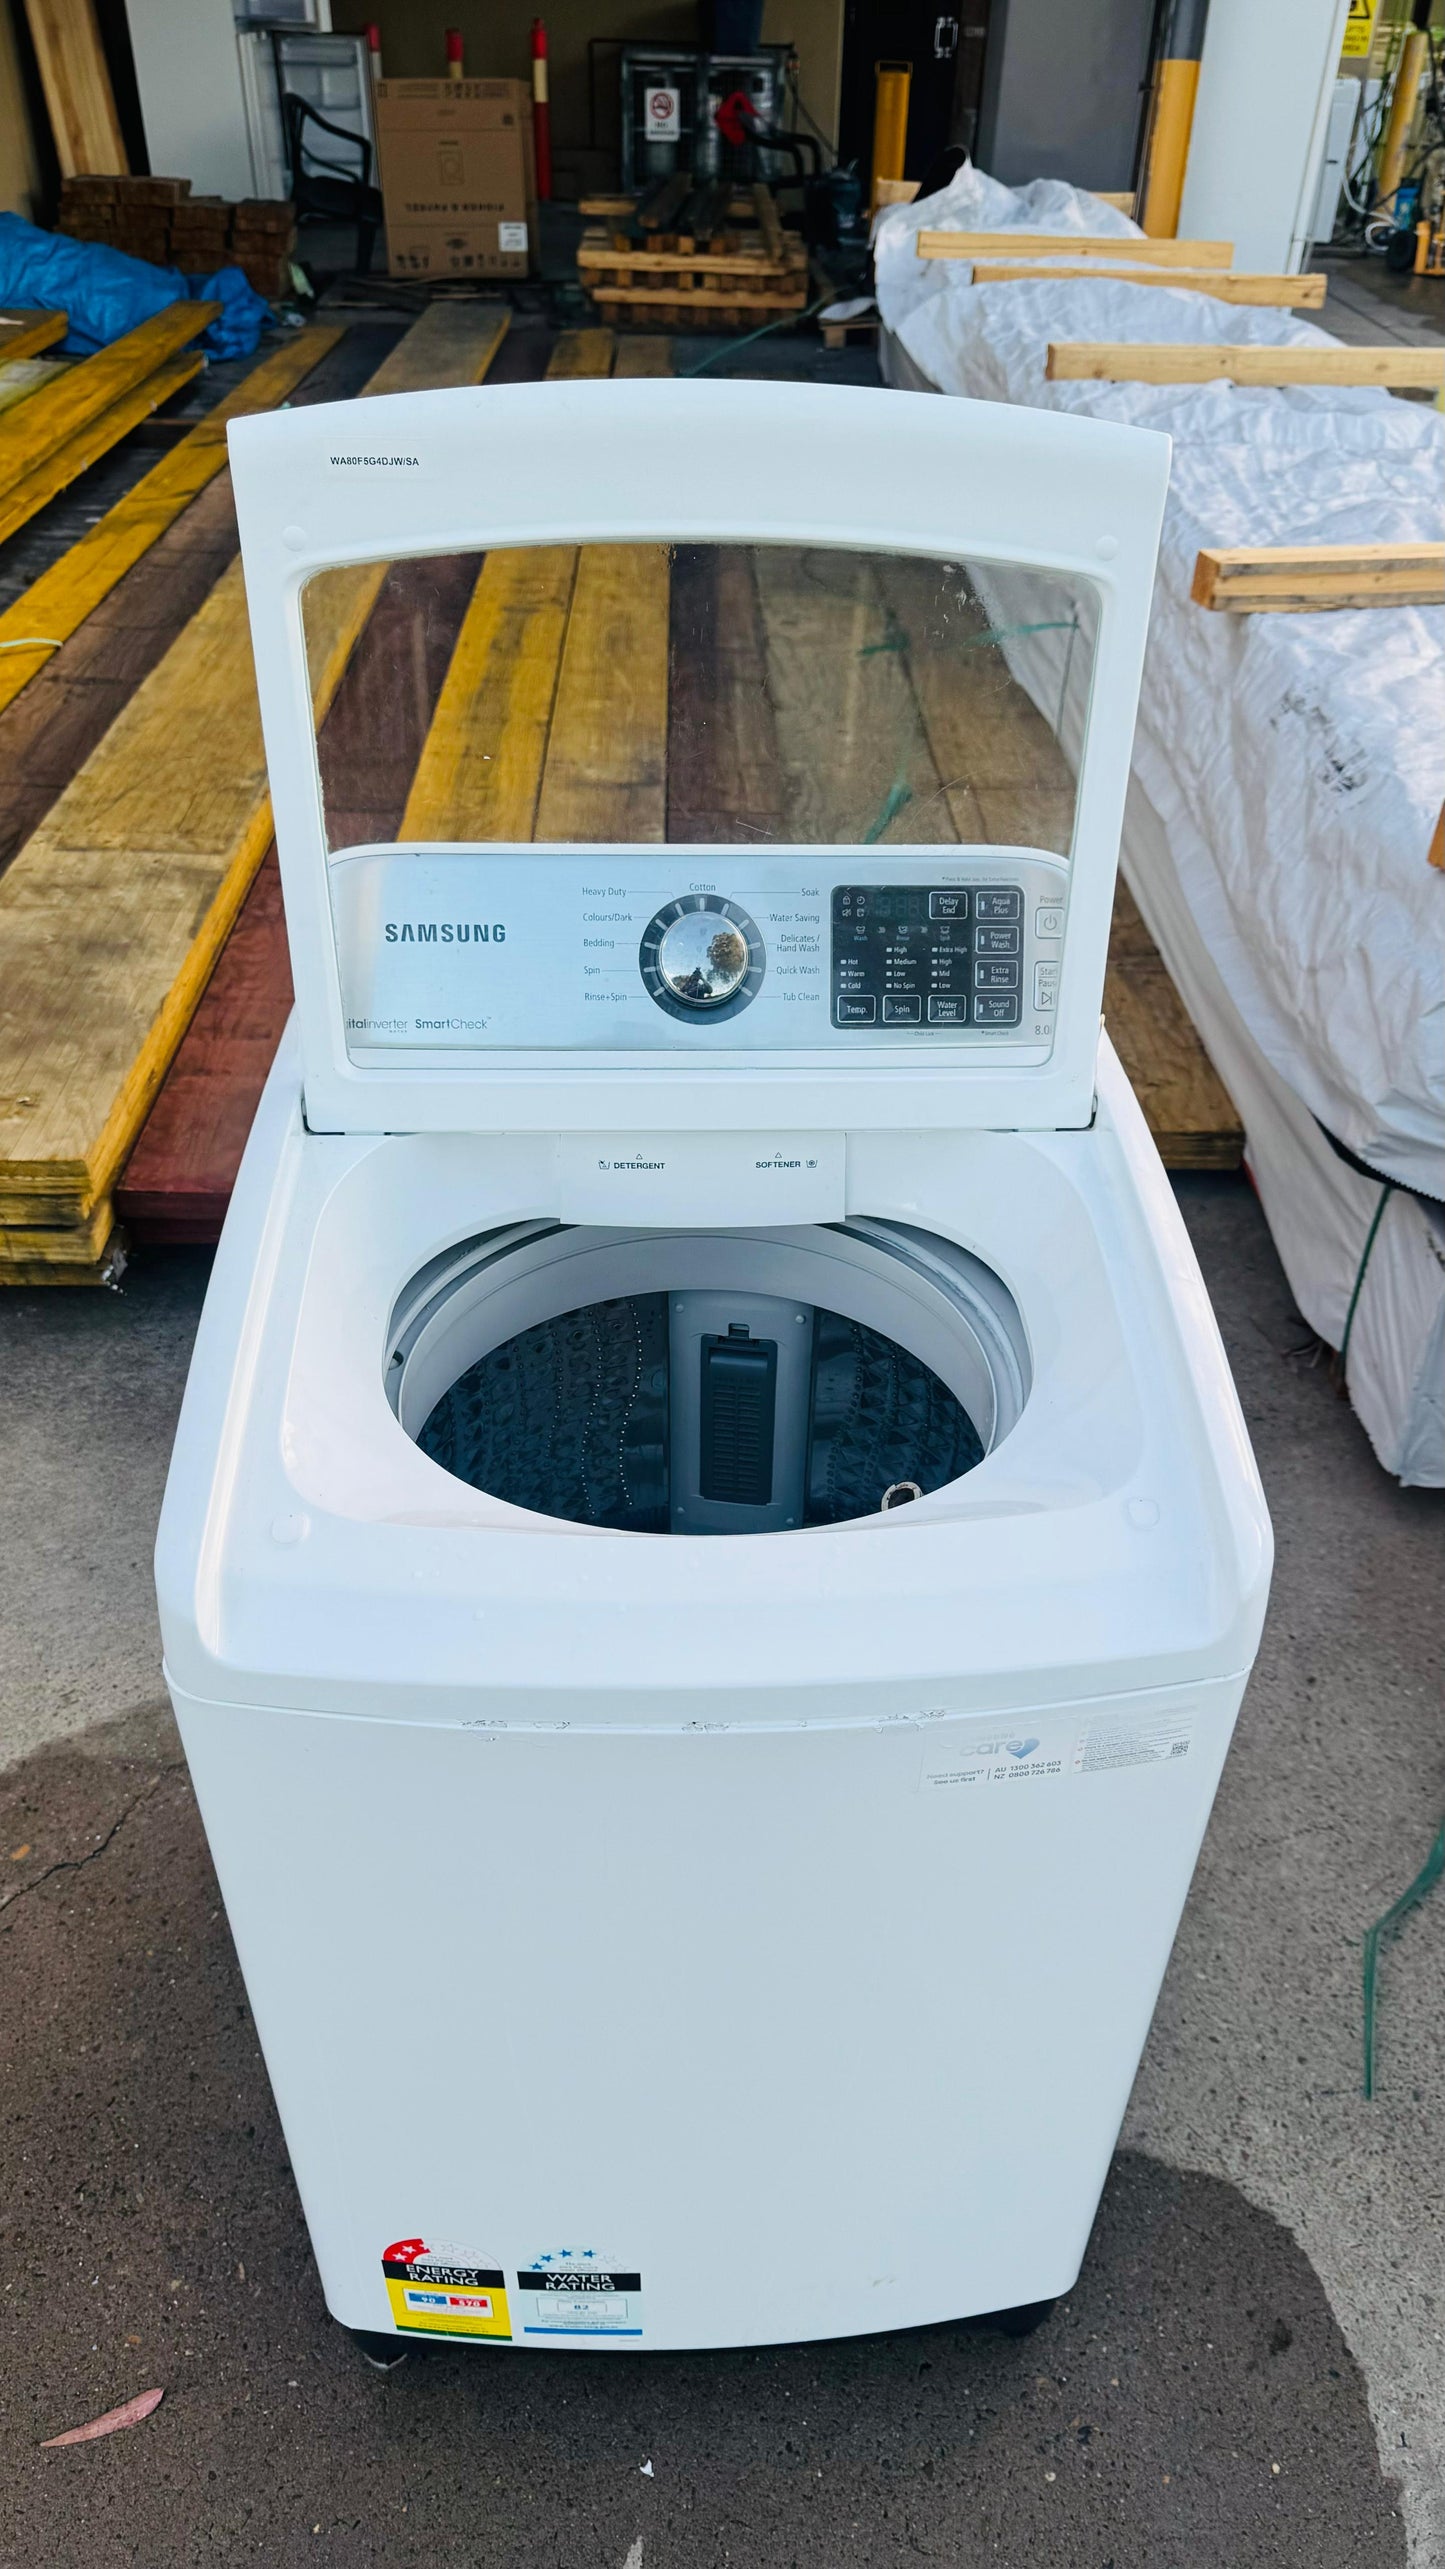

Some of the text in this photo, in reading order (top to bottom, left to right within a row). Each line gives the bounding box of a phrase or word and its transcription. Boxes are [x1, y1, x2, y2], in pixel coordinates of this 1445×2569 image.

[330, 456, 419, 466] WA80F5G4DJW/SA
[582, 887, 626, 897] Heavy Duty
[689, 883, 716, 892] Cotton
[801, 888, 820, 897] Soak
[939, 897, 959, 908] Delay
[992, 897, 1010, 907] Aqua
[1040, 895, 1063, 904] Power
[942, 906, 956, 914] End
[994, 906, 1009, 914] Plus
[583, 913, 632, 922] Colours/Dark
[770, 913, 820, 924] Water Saving
[385, 923, 506, 943] SAMSUNG
[990, 931, 1012, 940] Power
[781, 934, 815, 943] Delicates
[583, 938, 614, 949] Bedding
[991, 940, 1010, 949] Wash
[776, 944, 820, 953] Hand Wash
[939, 958, 952, 966] High
[584, 966, 600, 976] Spin
[776, 966, 820, 976] Quick Wash
[991, 966, 1009, 975] Extra
[991, 974, 1009, 983] Rinse
[584, 992, 627, 1003] Rinse+Spin
[782, 993, 820, 1002] Tub Clean
[937, 1000, 957, 1009] Water
[989, 1000, 1010, 1009] Sound
[847, 1005, 868, 1015] Temp.
[894, 1005, 910, 1015] Spin
[938, 1009, 956, 1017] Level
[993, 1008, 1005, 1017] Off
[614, 1162, 665, 1170] DETERGENT
[960, 1740, 1023, 1756] care
[1010, 1764, 1029, 1772] 1300
[949, 1769, 985, 1778] support?
[1008, 1770, 1030, 1778] 0800
[406, 2264, 479, 2278] ENERGY
[409, 2273, 478, 2286] RATING
[546, 2274, 612, 2283] WATER
[545, 2282, 615, 2291] RATING
